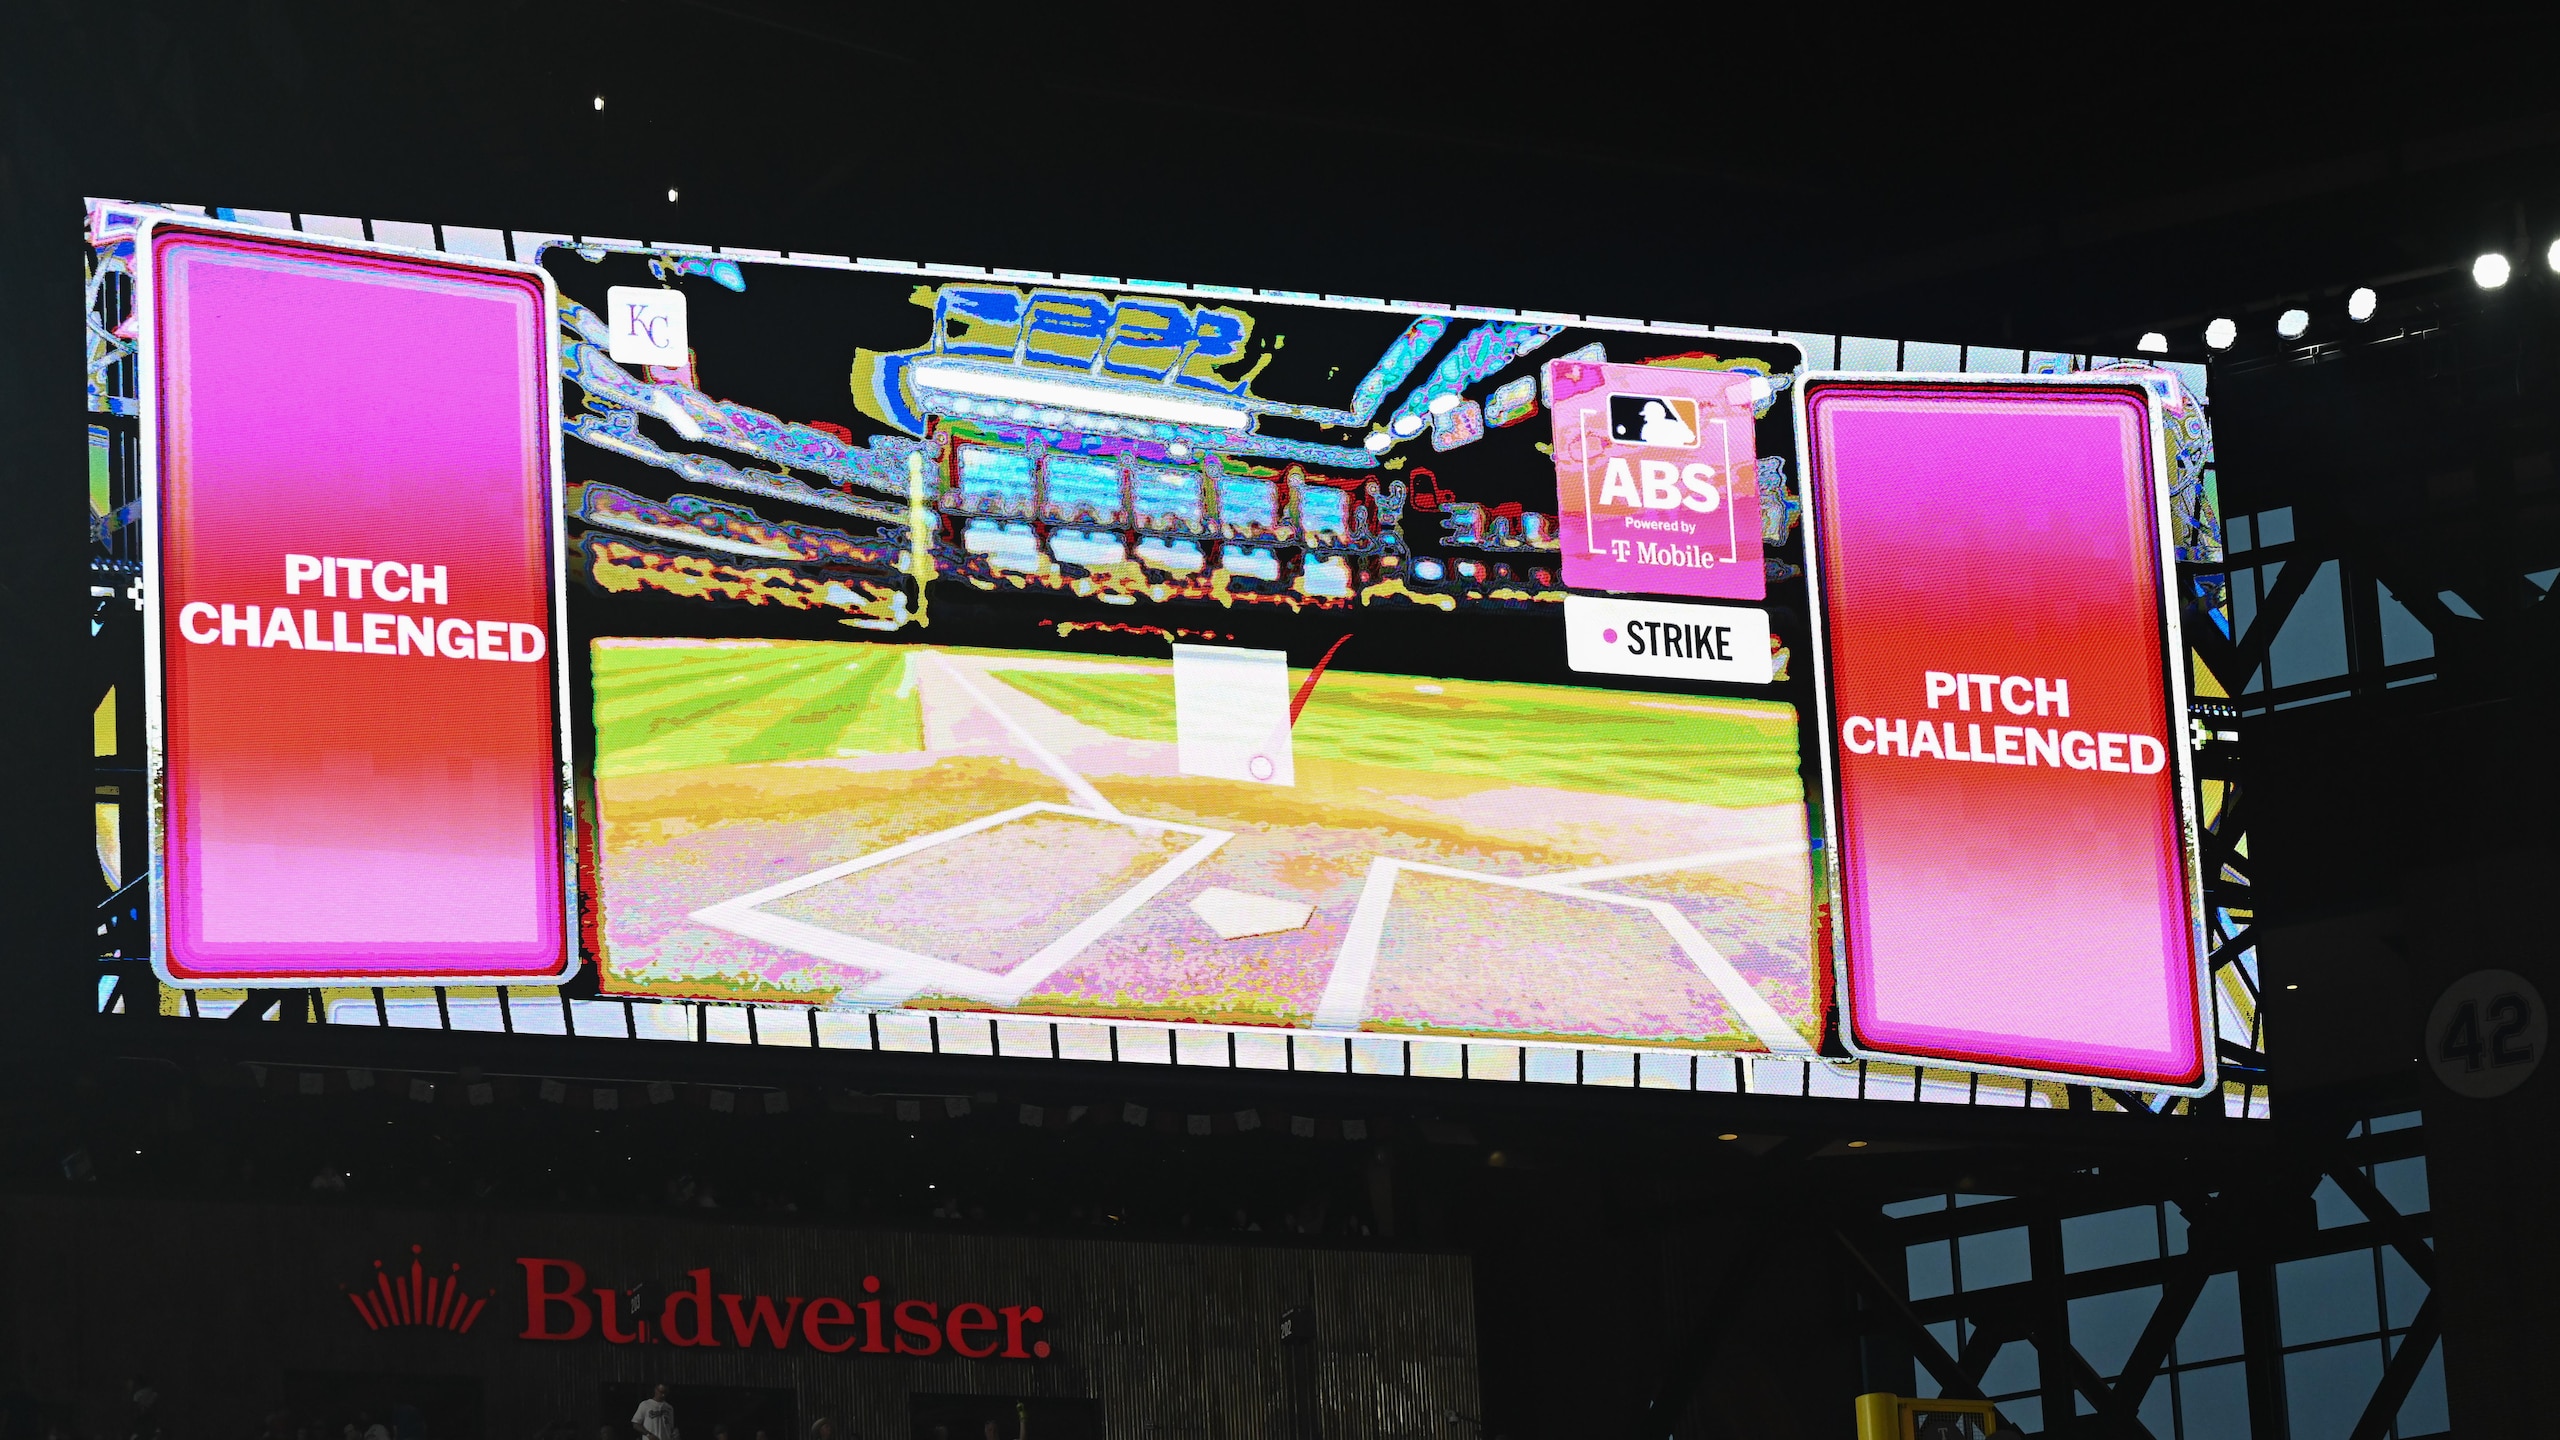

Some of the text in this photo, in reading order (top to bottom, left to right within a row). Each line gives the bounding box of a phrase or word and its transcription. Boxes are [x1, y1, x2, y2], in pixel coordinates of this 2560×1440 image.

[626, 303, 669, 348] KC
[1599, 457, 1721, 513] ABS
[1625, 517, 1696, 535] Powered by
[285, 553, 448, 605] PITCH
[1636, 541, 1715, 569] Mobile
[178, 601, 546, 663] CHALLENGED
[1626, 620, 1733, 662] STRIKE
[1924, 670, 2070, 717] PITCH
[1842, 715, 2166, 775] CHALLENGED
[2440, 992, 2534, 1073] 42
